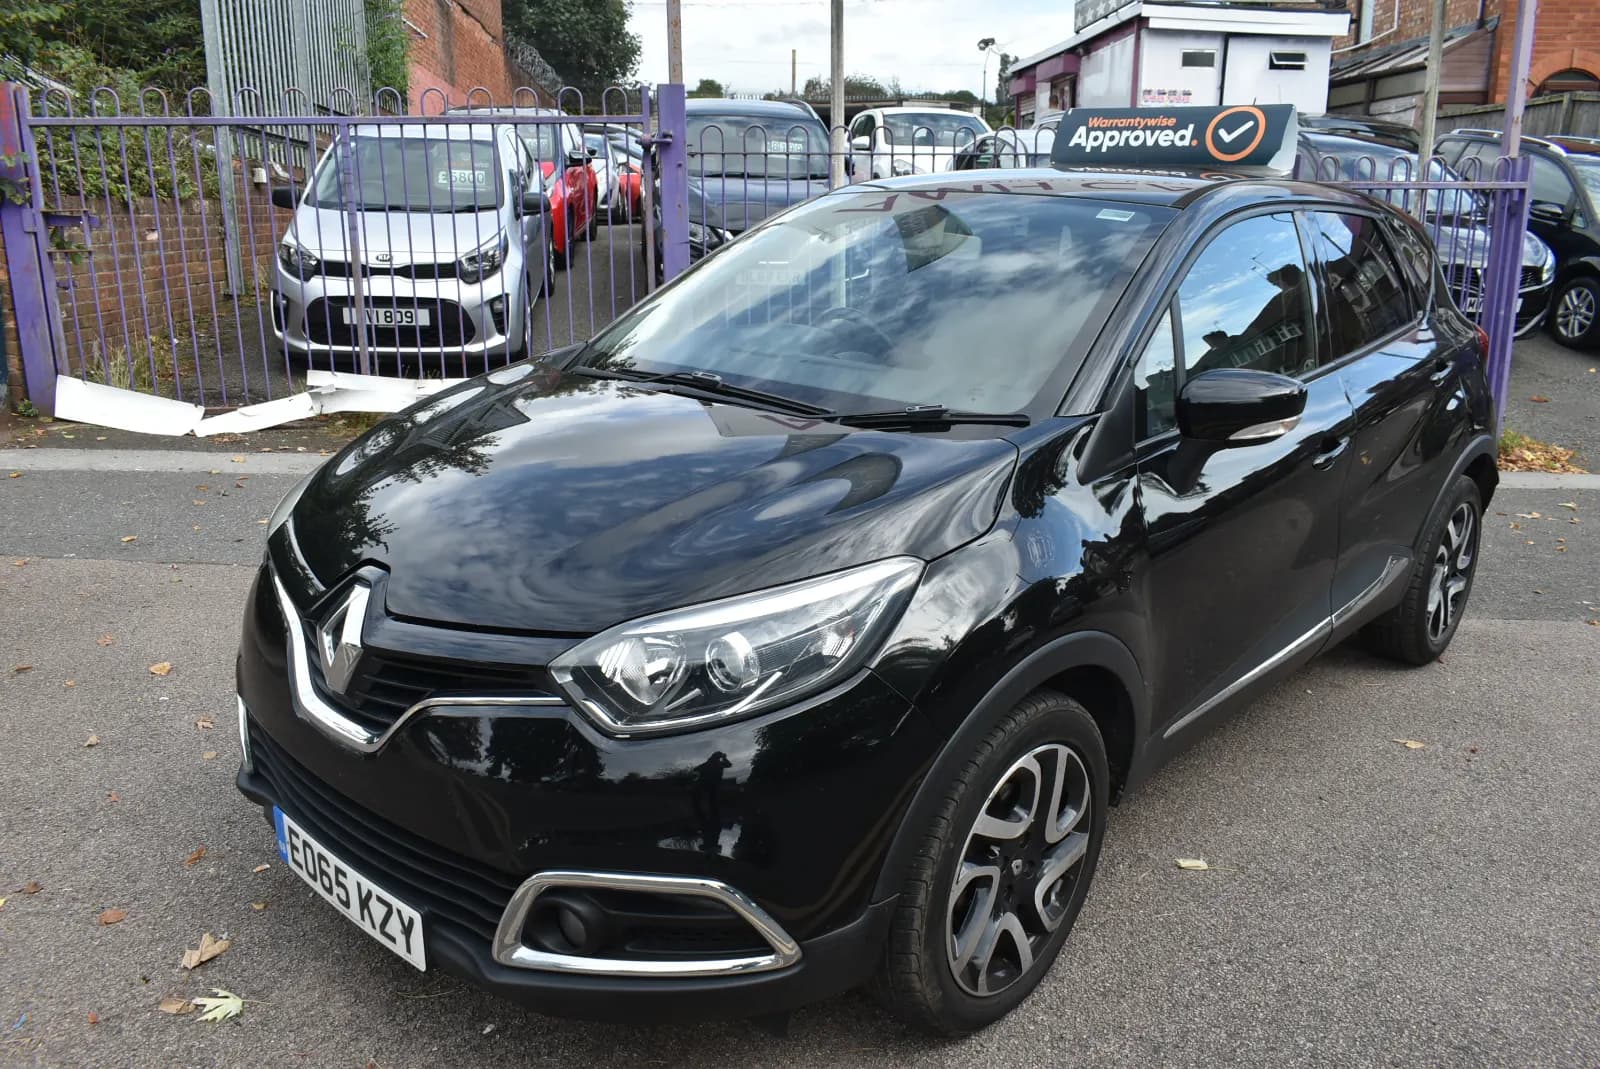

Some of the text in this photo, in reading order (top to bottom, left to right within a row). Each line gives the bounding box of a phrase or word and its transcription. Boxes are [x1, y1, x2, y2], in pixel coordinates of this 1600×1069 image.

[1088, 116, 1177, 128] Warrantywise
[1068, 124, 1198, 152] Approved.
[288, 825, 414, 956] EO65 KZY
